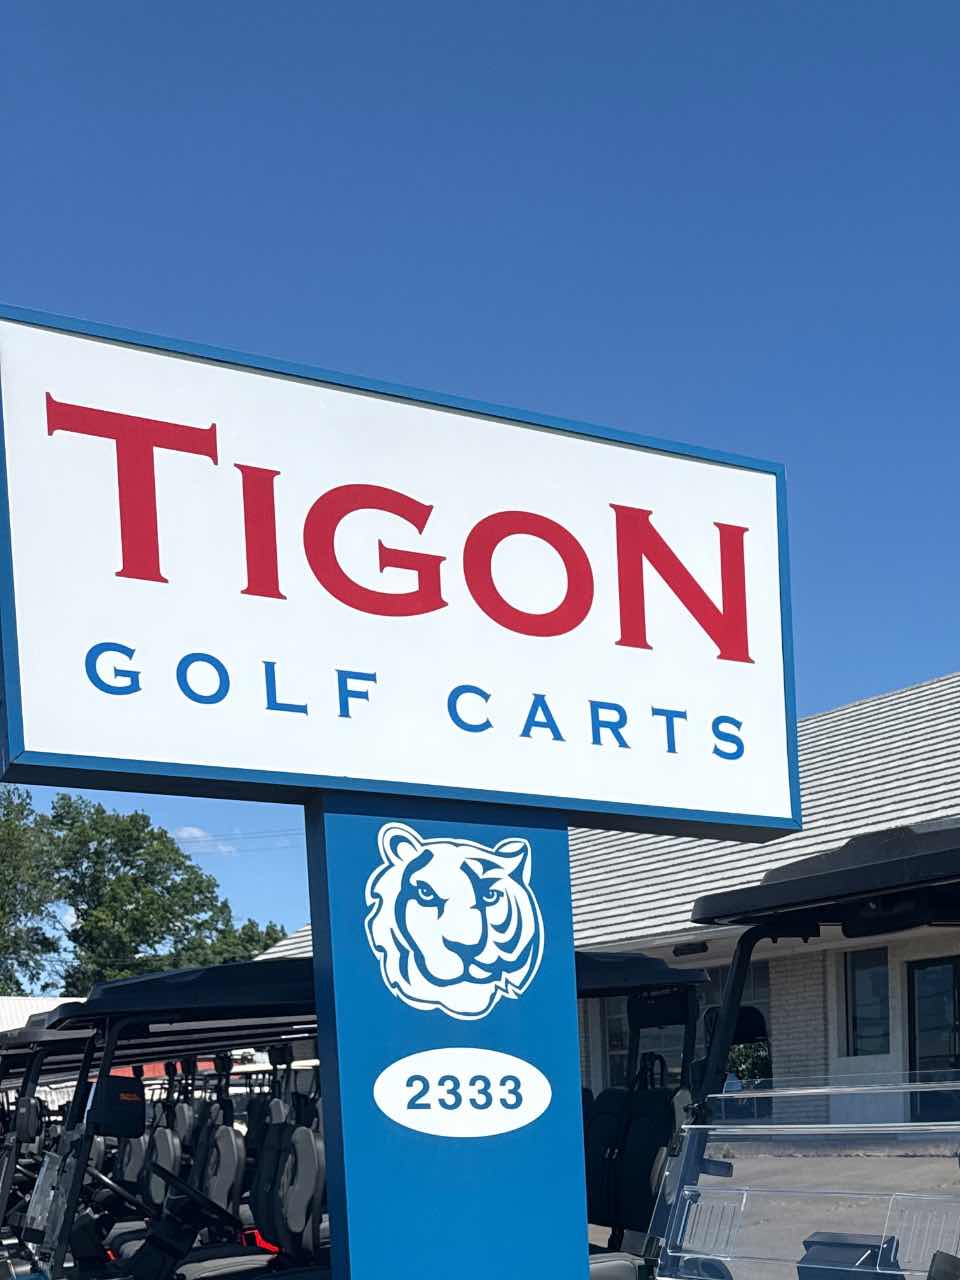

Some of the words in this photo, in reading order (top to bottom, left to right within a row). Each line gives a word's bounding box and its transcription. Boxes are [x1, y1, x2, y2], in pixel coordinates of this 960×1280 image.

[46, 391, 755, 664] TIGON
[84, 641, 377, 718] GOLF
[447, 683, 745, 760] CARTS
[405, 1074, 523, 1110] 2333
